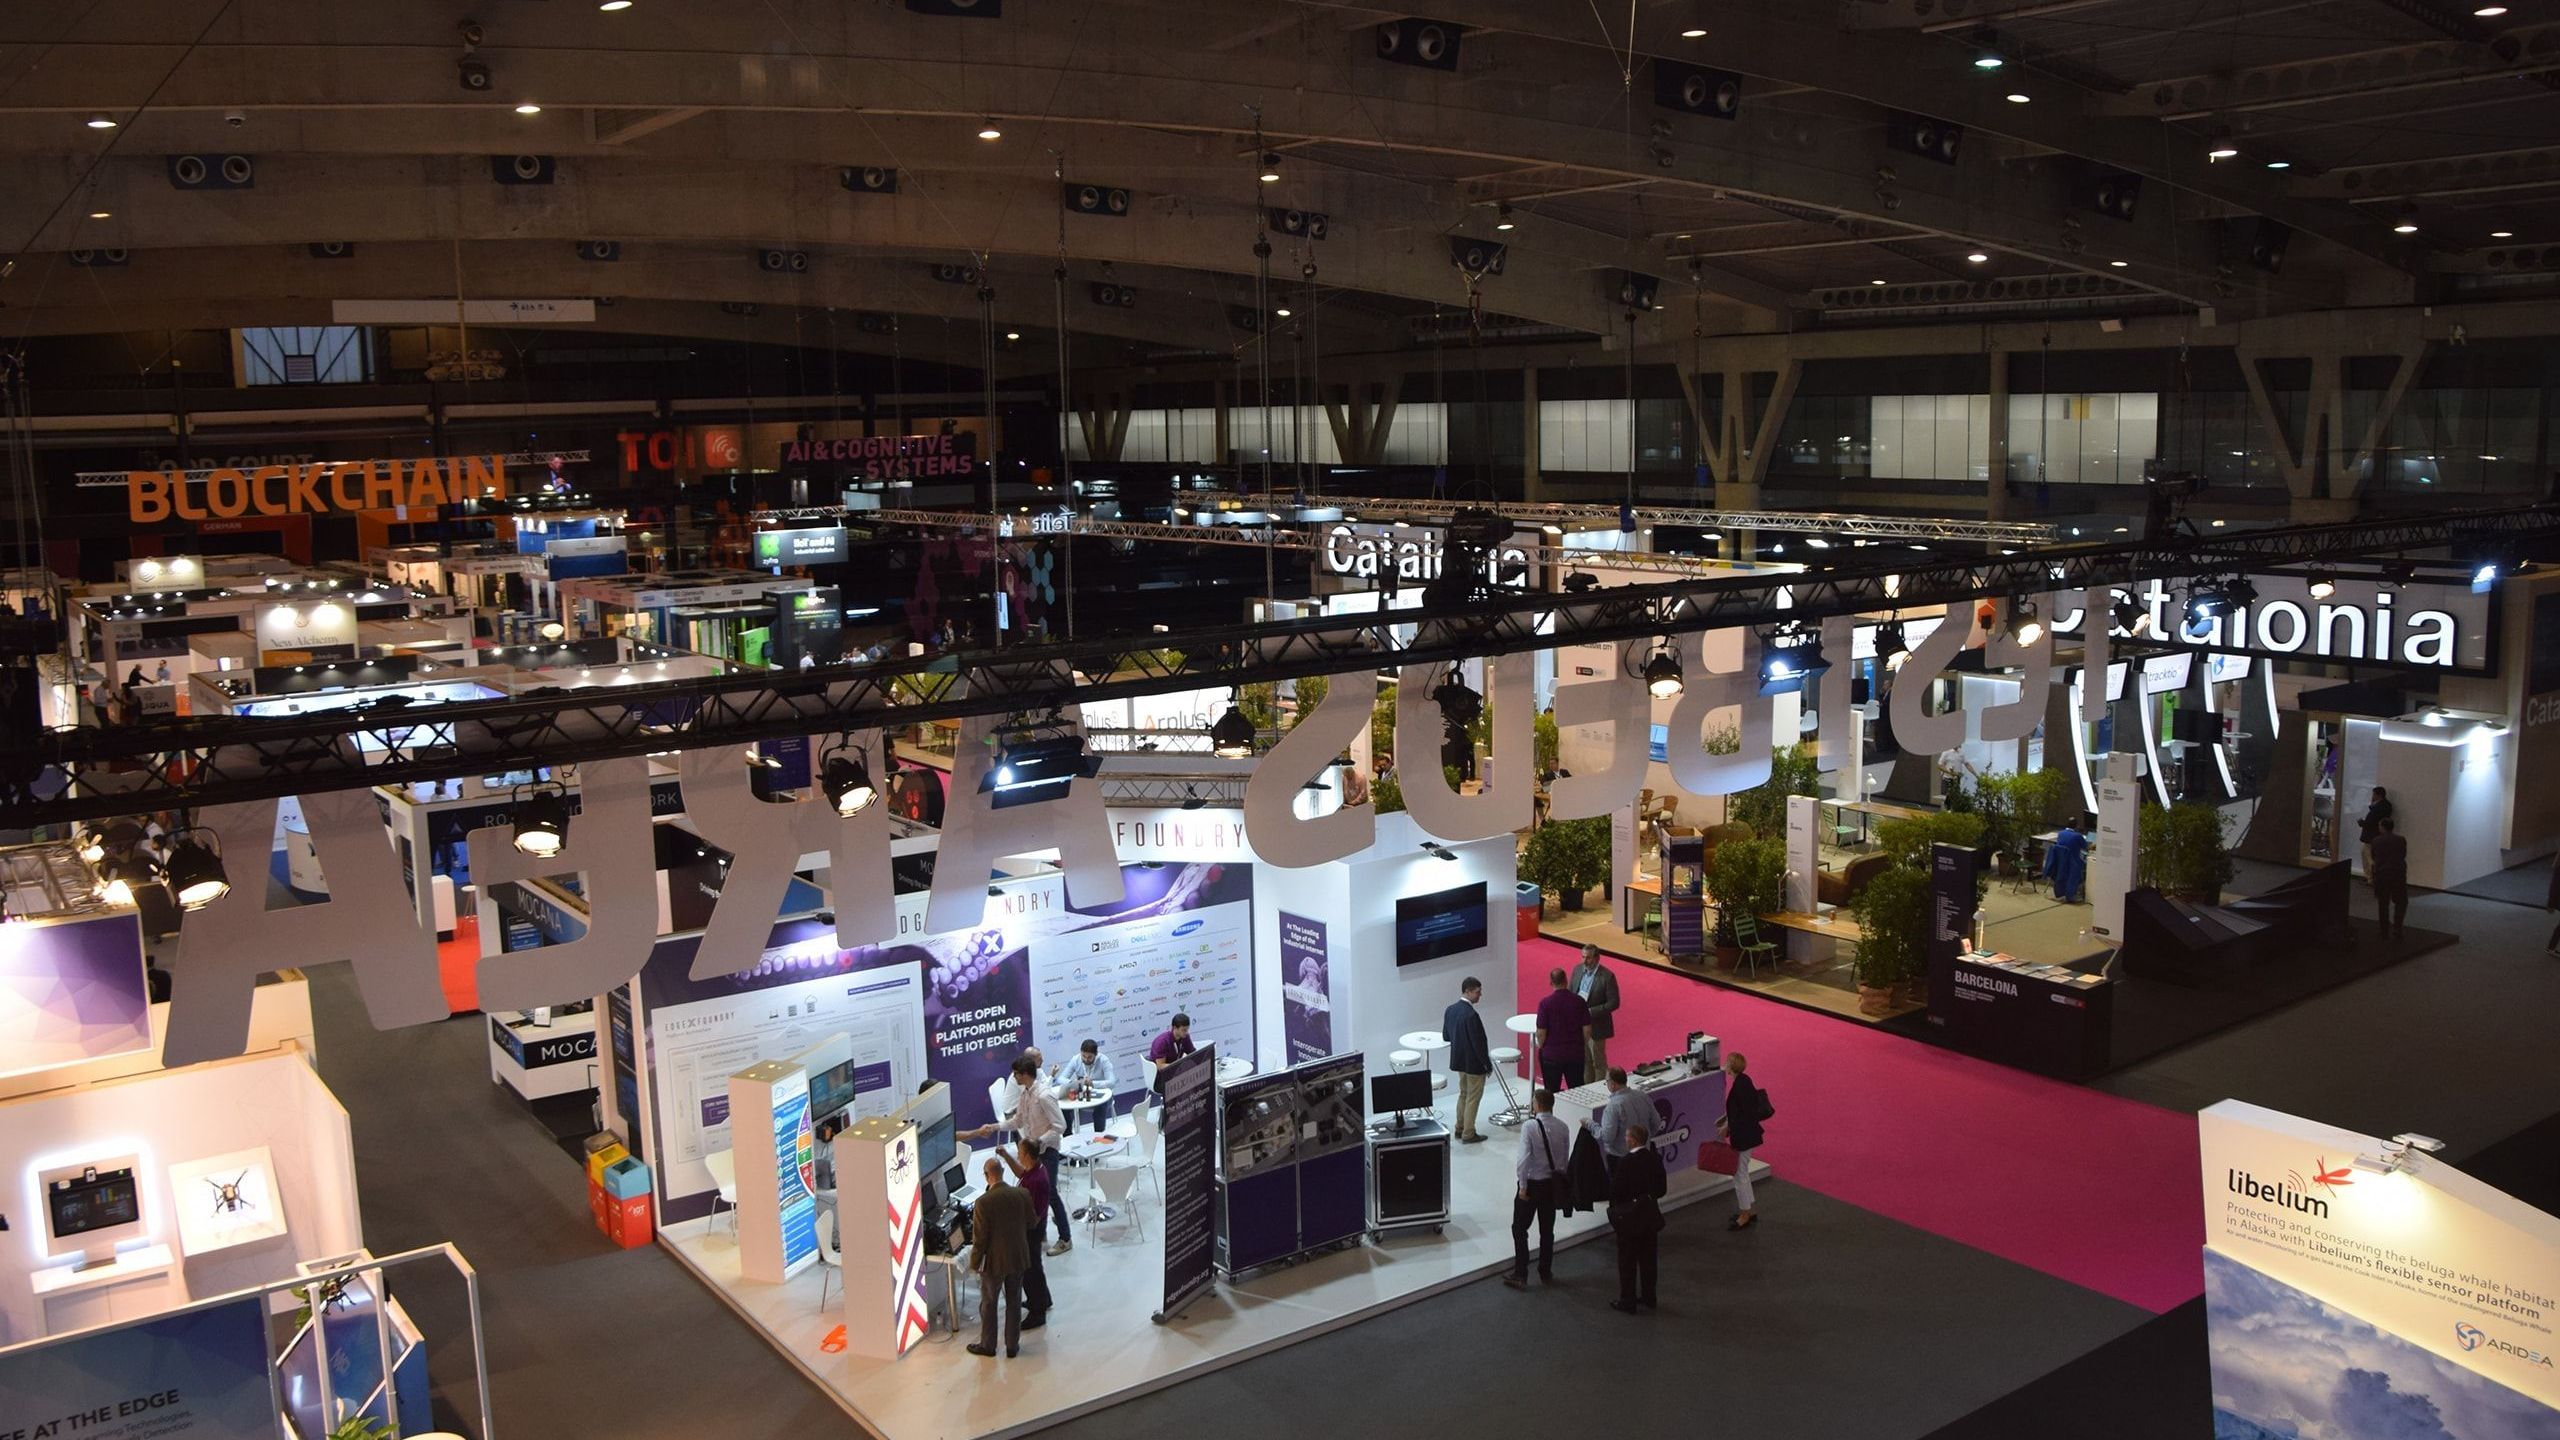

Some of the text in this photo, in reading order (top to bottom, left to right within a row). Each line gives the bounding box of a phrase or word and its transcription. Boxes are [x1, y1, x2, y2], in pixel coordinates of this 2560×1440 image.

[831, 434, 953, 461] COGNITIVE
[865, 454, 973, 479] SYSTEMS
[127, 454, 507, 523] BLOCKCHAIN
[2148, 667, 2178, 682] tracktio
[517, 887, 563, 934] MOCANA
[1284, 937, 1325, 956] Industrial Internet
[1290, 931, 1302, 942] Edge
[1301, 926, 1320, 940] Leading
[1954, 970, 2018, 997] BARCELONA
[949, 1004, 1006, 1025] THE OPEN
[936, 1016, 1021, 1044] PLATFORM FOR
[940, 1031, 1019, 1058] THE IOT EDGE.
[1292, 1038, 1326, 1057] Interoperate
[2228, 1167, 2329, 1219] libelium
[2226, 1201, 2556, 1310] Protecting and conserving the beluga whale habitat
[2226, 1215, 2540, 1320] in Alaska with Libelium's flexible sensor platform
[2235, 1231, 2247, 1240] and
[2247, 1236, 2264, 1244] water
[2264, 1240, 2298, 1257] monitoring
[2310, 1255, 2320, 1264] gas
[2321, 1257, 2334, 1267] leak
[2343, 1263, 2353, 1272] the
[2354, 1266, 2370, 1278] Cook
[2418, 1286, 2437, 1299] home
[2447, 1296, 2459, 1306] the
[2459, 1301, 2502, 1319] endangered
[2502, 1313, 2528, 1328] Beluga
[2529, 1321, 2553, 1335] Whale
[2486, 1338, 2555, 1369] ARIDEA
[34, 1419, 61, 1440] AT
[67, 1406, 112, 1430] THE
[118, 1389, 180, 1418] EDGE
